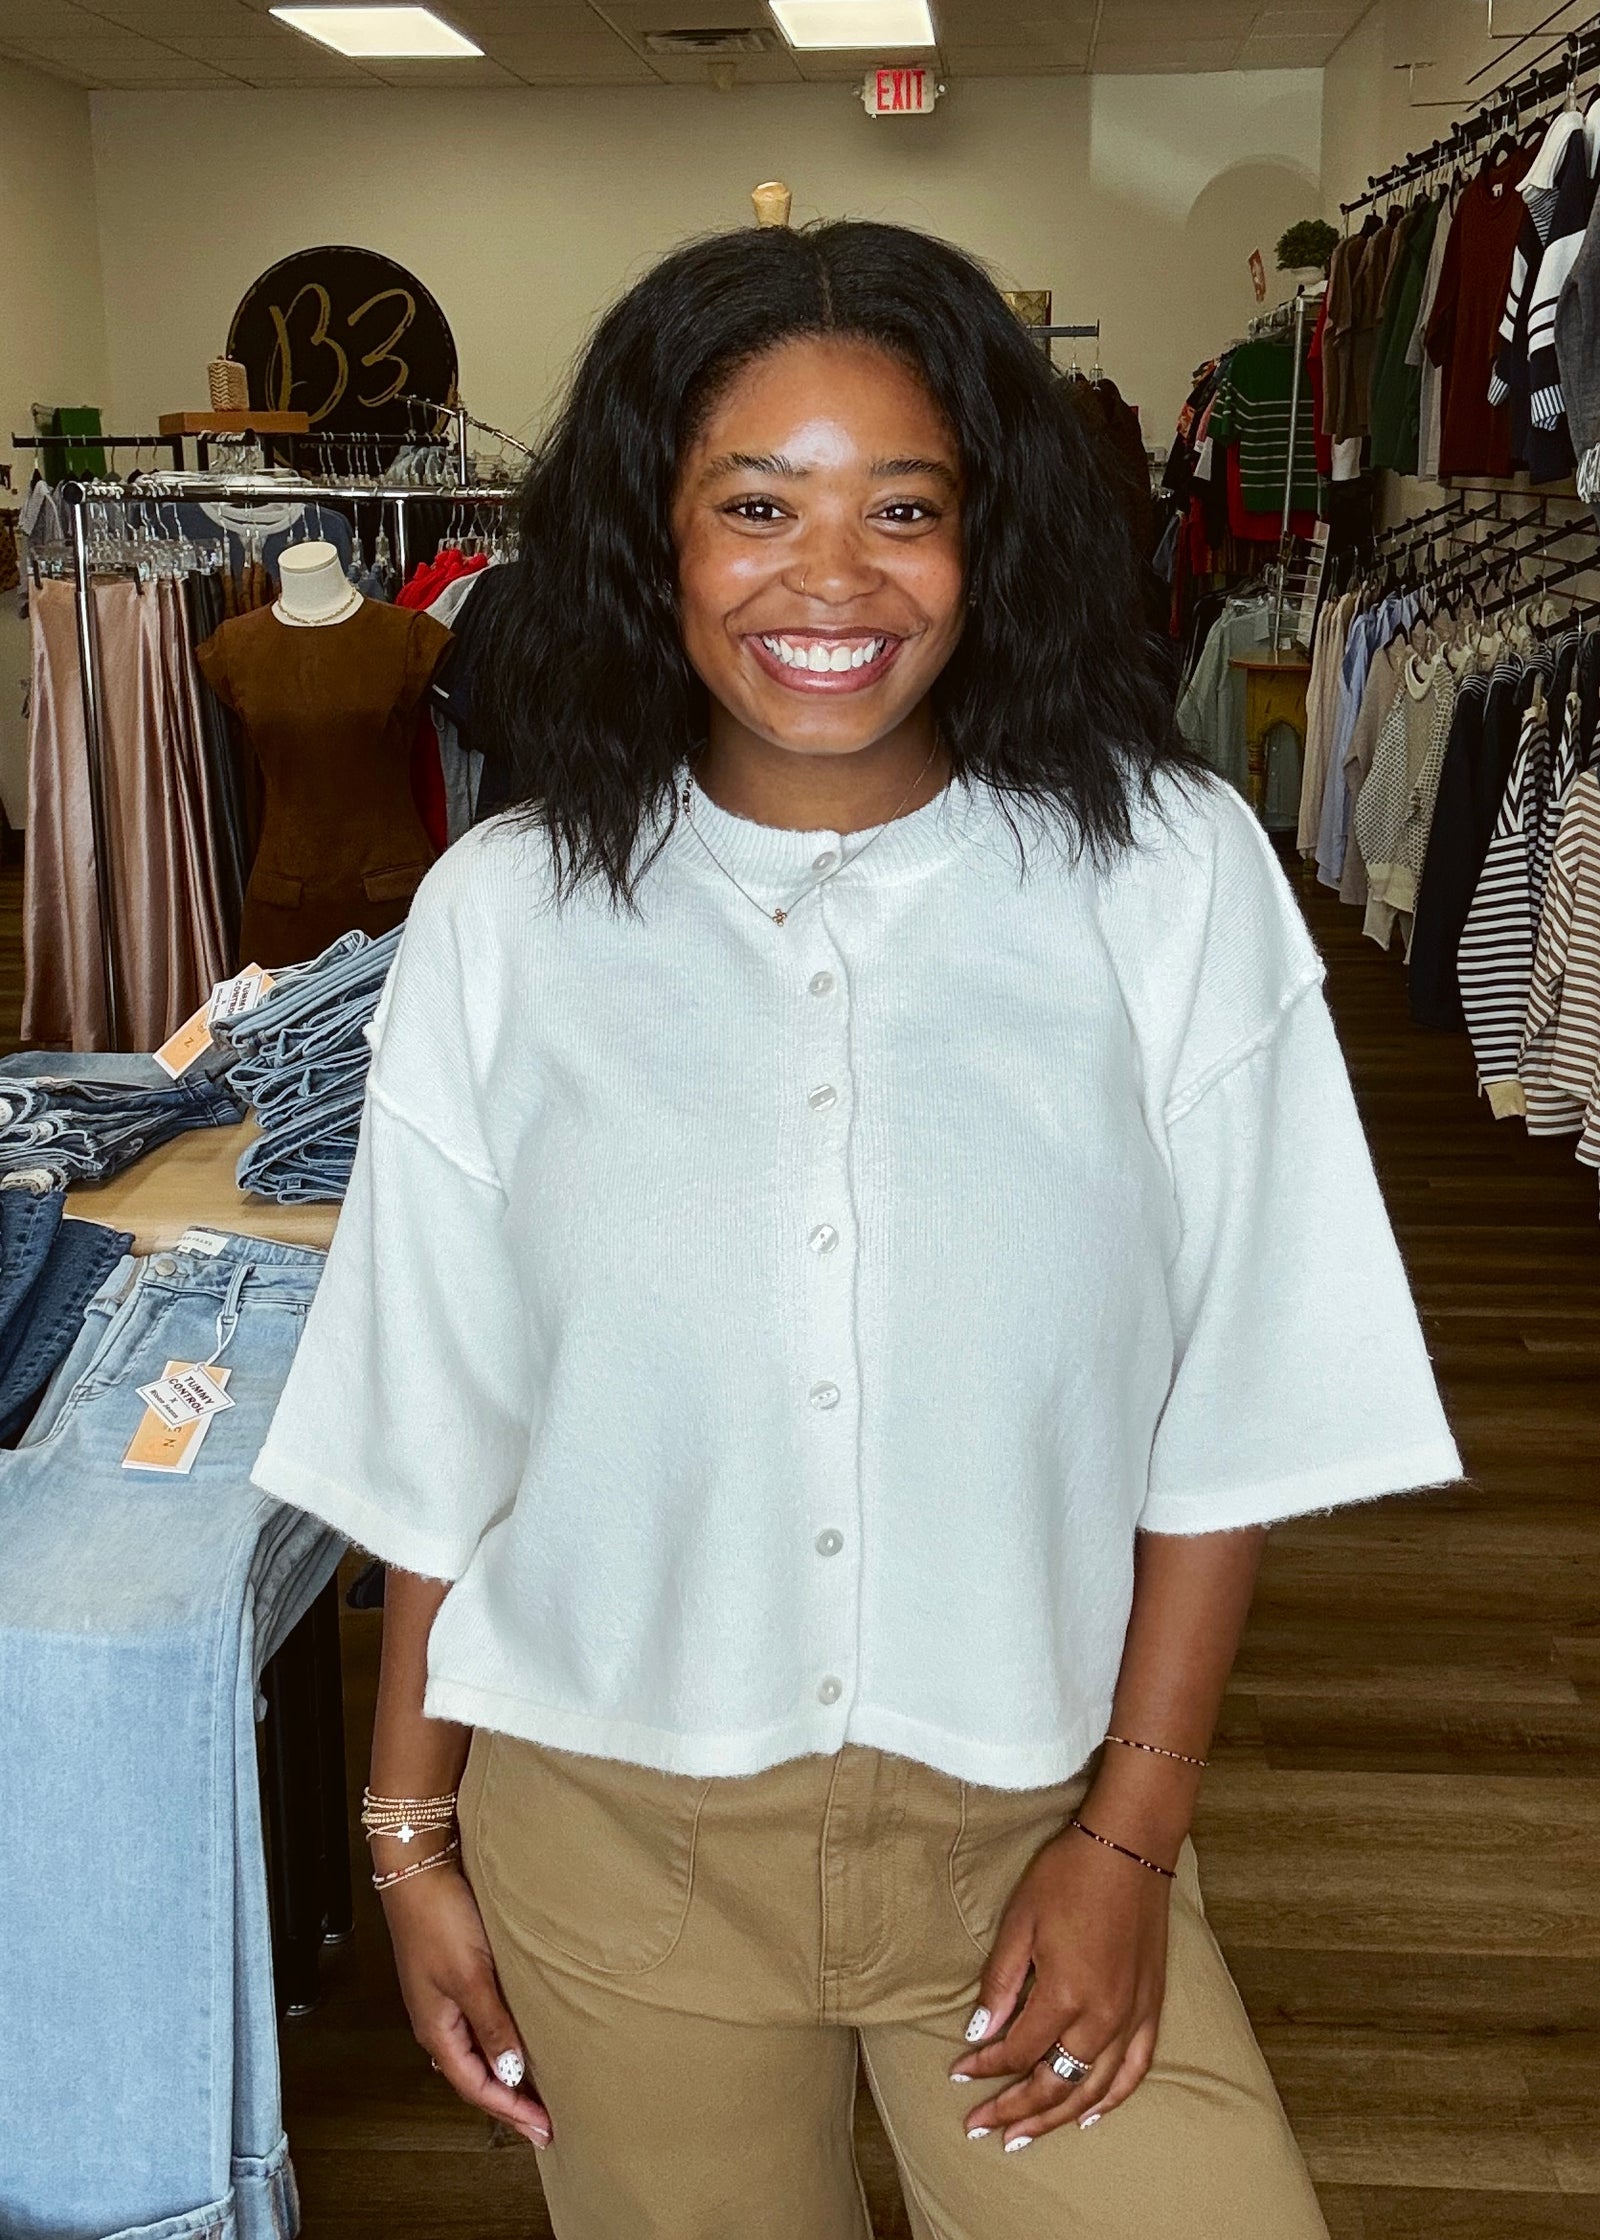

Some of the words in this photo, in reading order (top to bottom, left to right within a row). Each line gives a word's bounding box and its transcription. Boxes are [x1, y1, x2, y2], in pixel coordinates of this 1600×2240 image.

[876, 69, 926, 110] EXIT
[265, 283, 415, 424] B3
[168, 1378, 204, 1414] CONTROL
[184, 1376, 215, 1405] TUMMY
